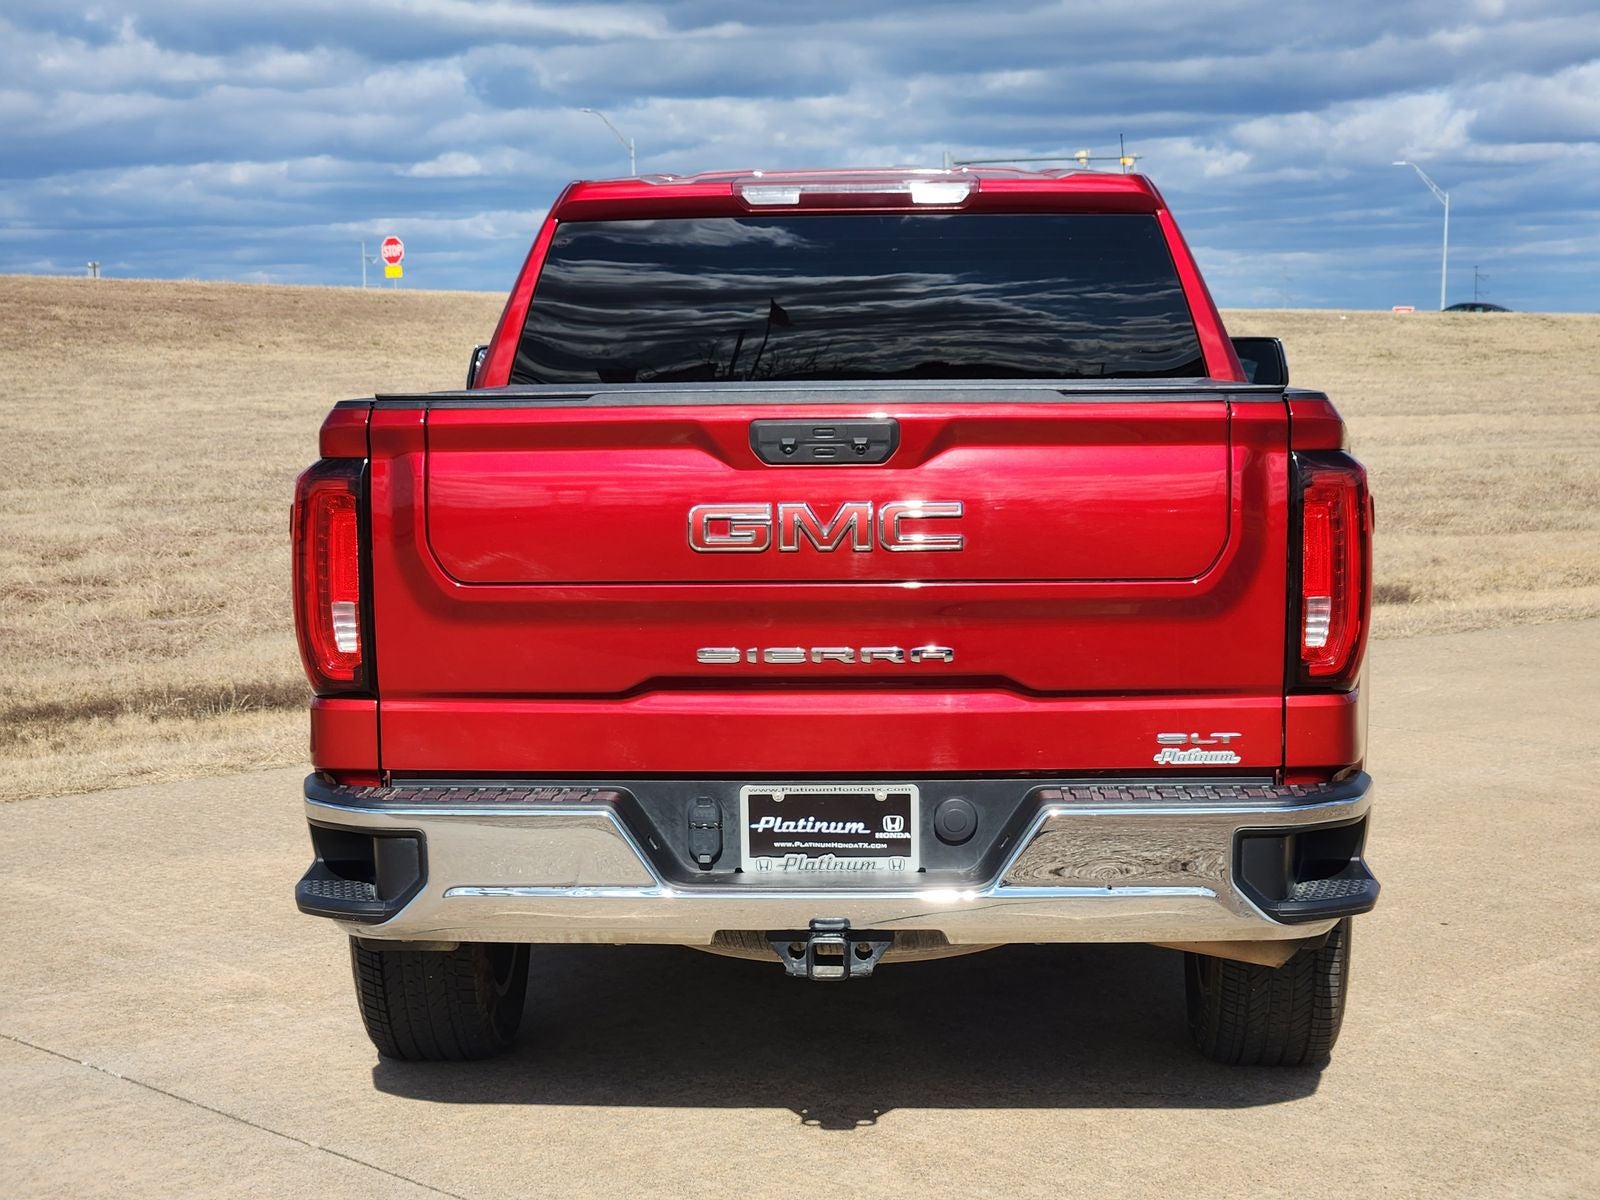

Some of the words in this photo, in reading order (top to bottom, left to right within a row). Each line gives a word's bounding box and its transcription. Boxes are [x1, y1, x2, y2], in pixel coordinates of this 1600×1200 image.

[688, 501, 964, 553] GMC
[696, 645, 955, 664] SIERRA
[1156, 732, 1242, 745] SLT
[1153, 748, 1242, 765] Platinum
[750, 816, 871, 834] Platinum
[777, 855, 884, 872] Platinum
